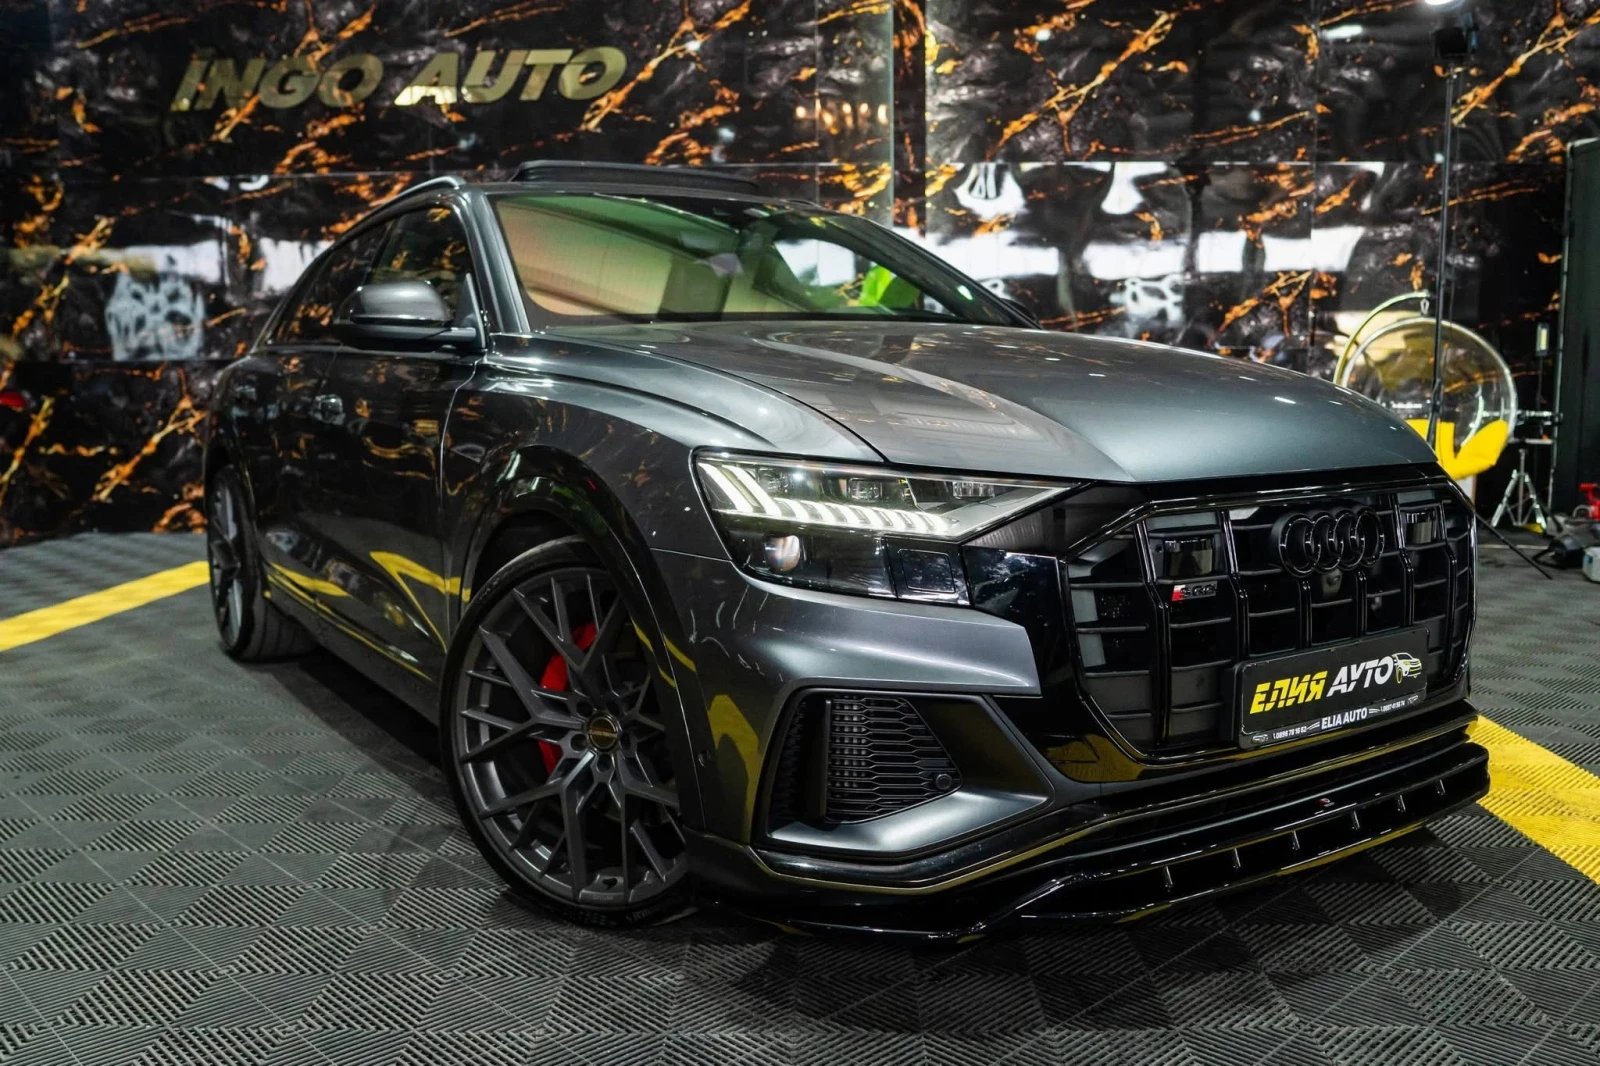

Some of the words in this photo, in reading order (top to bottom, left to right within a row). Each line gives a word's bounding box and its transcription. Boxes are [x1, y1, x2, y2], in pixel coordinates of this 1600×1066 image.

[394, 46, 627, 106] AUTO
[1321, 712, 1343, 730] ELIA
[1343, 707, 1368, 726] AUTO
